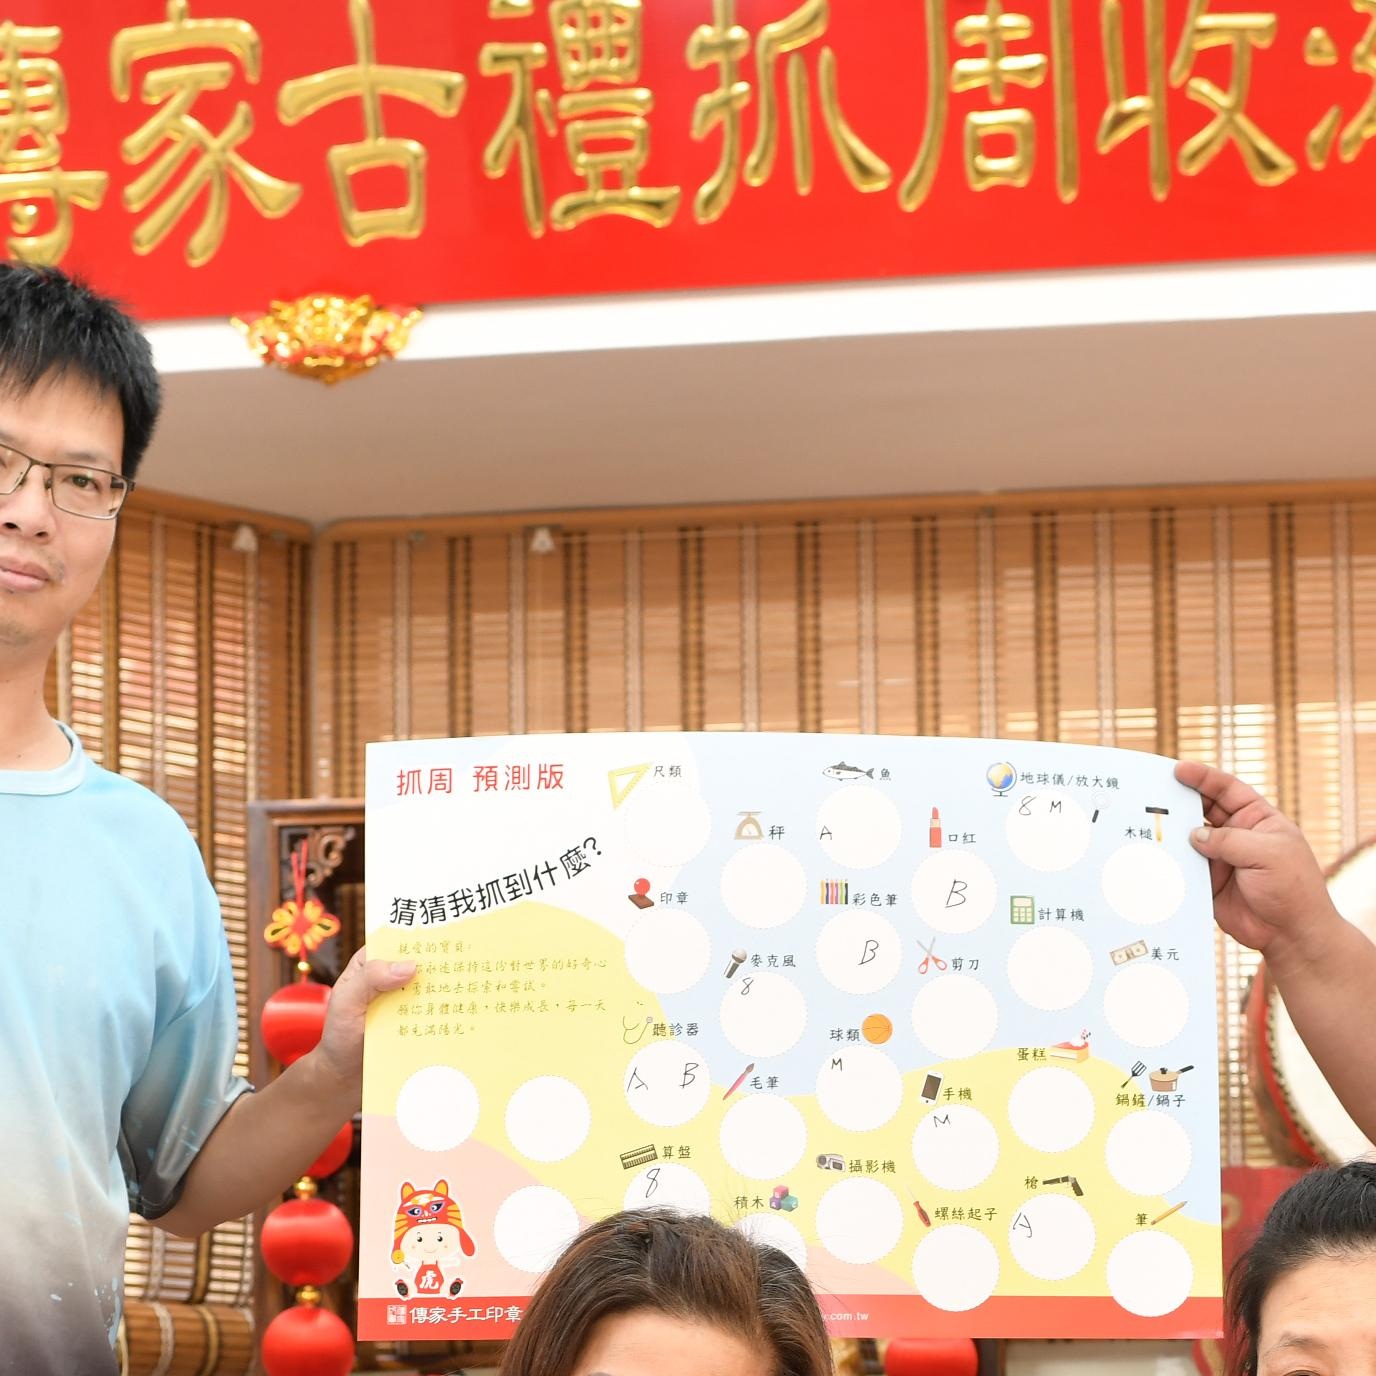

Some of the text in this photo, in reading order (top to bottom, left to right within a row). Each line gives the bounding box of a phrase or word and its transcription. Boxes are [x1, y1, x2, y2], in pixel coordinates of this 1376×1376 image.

[653, 765, 682, 778] 尺類
[879, 768, 892, 781] 魚
[396, 764, 564, 796] 抓周 預測版
[768, 825, 785, 840] 秤
[948, 832, 976, 844] 口紅
[389, 836, 602, 926] 猜猜我抓到什麼?
[660, 891, 689, 905] 印章
[852, 893, 898, 907] 彩色筆
[945, 879, 968, 908] B
[1038, 907, 1084, 921] 計算機
[857, 940, 879, 965] B
[1151, 947, 1180, 961] 美元
[750, 954, 796, 968] 麥克風
[952, 957, 979, 971] 剪刀
[652, 1023, 699, 1037] 聽診器
[829, 1028, 860, 1042] 球類
[1017, 1047, 1047, 1061] 蛋糕
[679, 1062, 699, 1088] B
[750, 1076, 779, 1090] 毛筆
[943, 1087, 972, 1101] 手機
[662, 1145, 692, 1159] 算盤
[848, 1159, 897, 1174] 攝影機
[1024, 1175, 1038, 1190] 槍
[734, 1195, 765, 1209] 積木
[934, 1207, 998, 1221] 螺絲起子
[1136, 1212, 1148, 1226] 筆
[419, 1269, 439, 1290] 虎
[409, 1306, 524, 1324] 傳家手工印章
